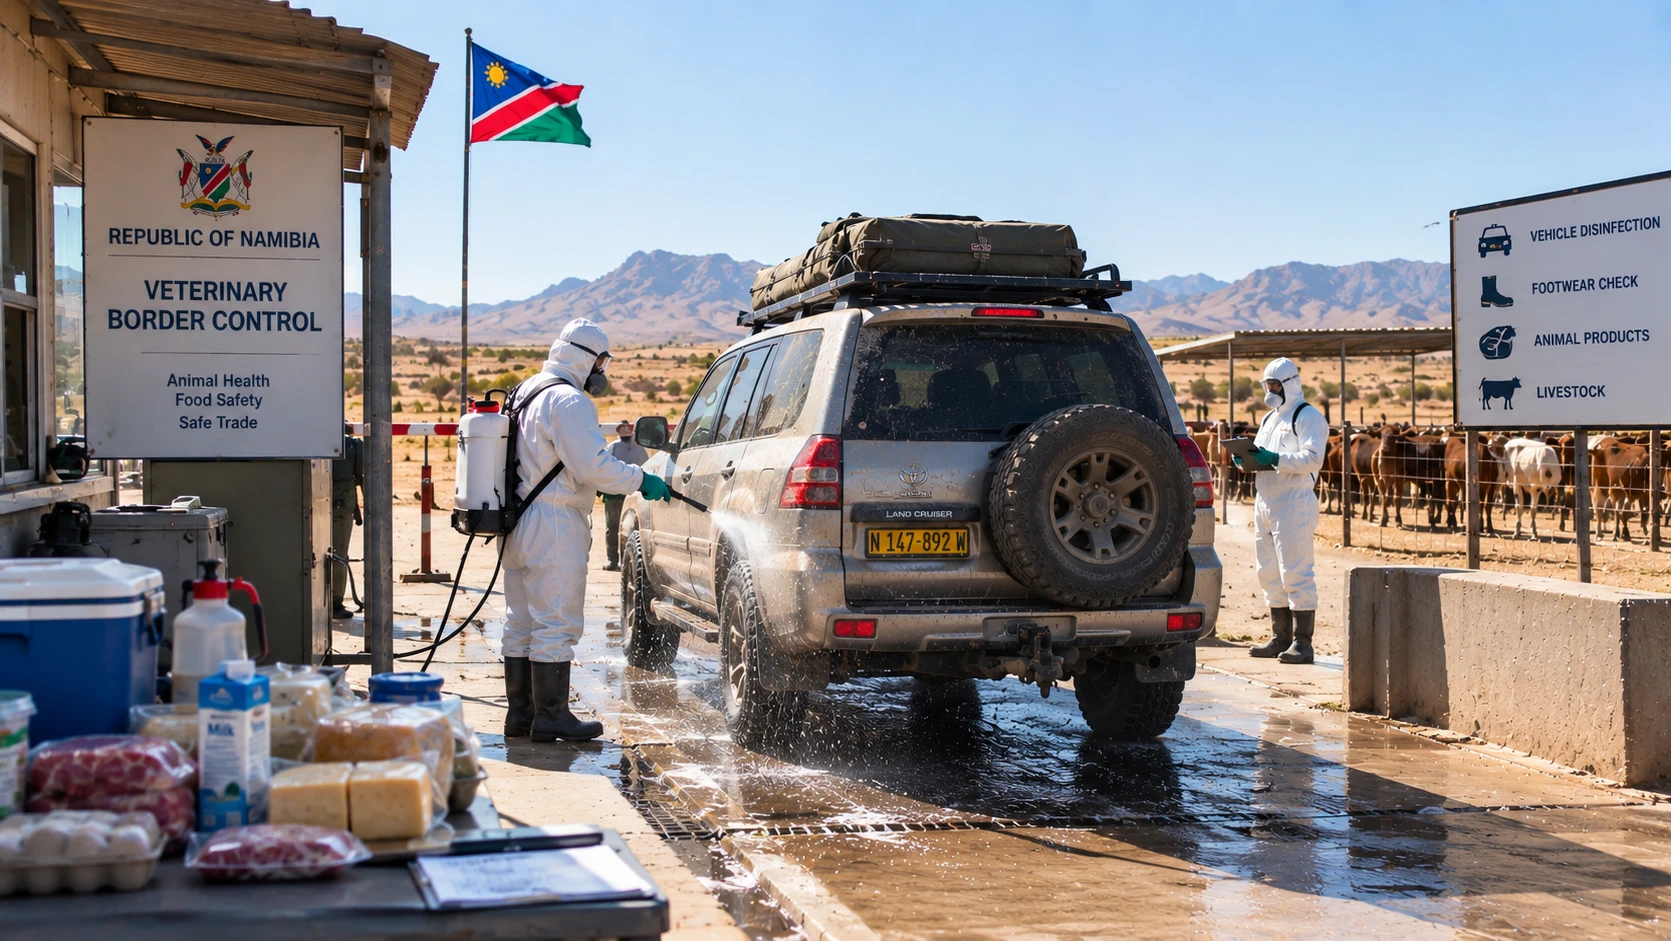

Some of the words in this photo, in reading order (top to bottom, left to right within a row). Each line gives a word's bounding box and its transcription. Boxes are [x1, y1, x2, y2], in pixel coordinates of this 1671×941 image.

[1530, 226, 1577, 242] VEHICLE
[1580, 216, 1660, 237] DISINFECTION
[108, 228, 203, 246] REPUBLIC
[209, 230, 234, 247] OF
[240, 230, 320, 248] NAMIBIA
[144, 280, 288, 302] VETERINARY
[1532, 278, 1596, 294] FOOTWEAR
[1598, 275, 1638, 290] CHECK
[108, 309, 204, 331] BORDER
[212, 310, 322, 332] CONTROL
[1534, 332, 1580, 346] ANIMAL
[1584, 329, 1650, 344] PRODUCTS
[167, 373, 218, 388] Animal
[224, 373, 270, 388] Health
[1537, 385, 1606, 398] LIVESTOCK
[175, 393, 212, 406] Food
[216, 393, 262, 410] Safety
[179, 416, 212, 430] Safe
[216, 416, 258, 430] Trade
[886, 510, 912, 518] LAND
[914, 510, 952, 518] CRUISER
[870, 532, 880, 552] N
[886, 532, 950, 552] 147-892
[956, 532, 966, 552] W
[207, 722, 235, 737] Milk
